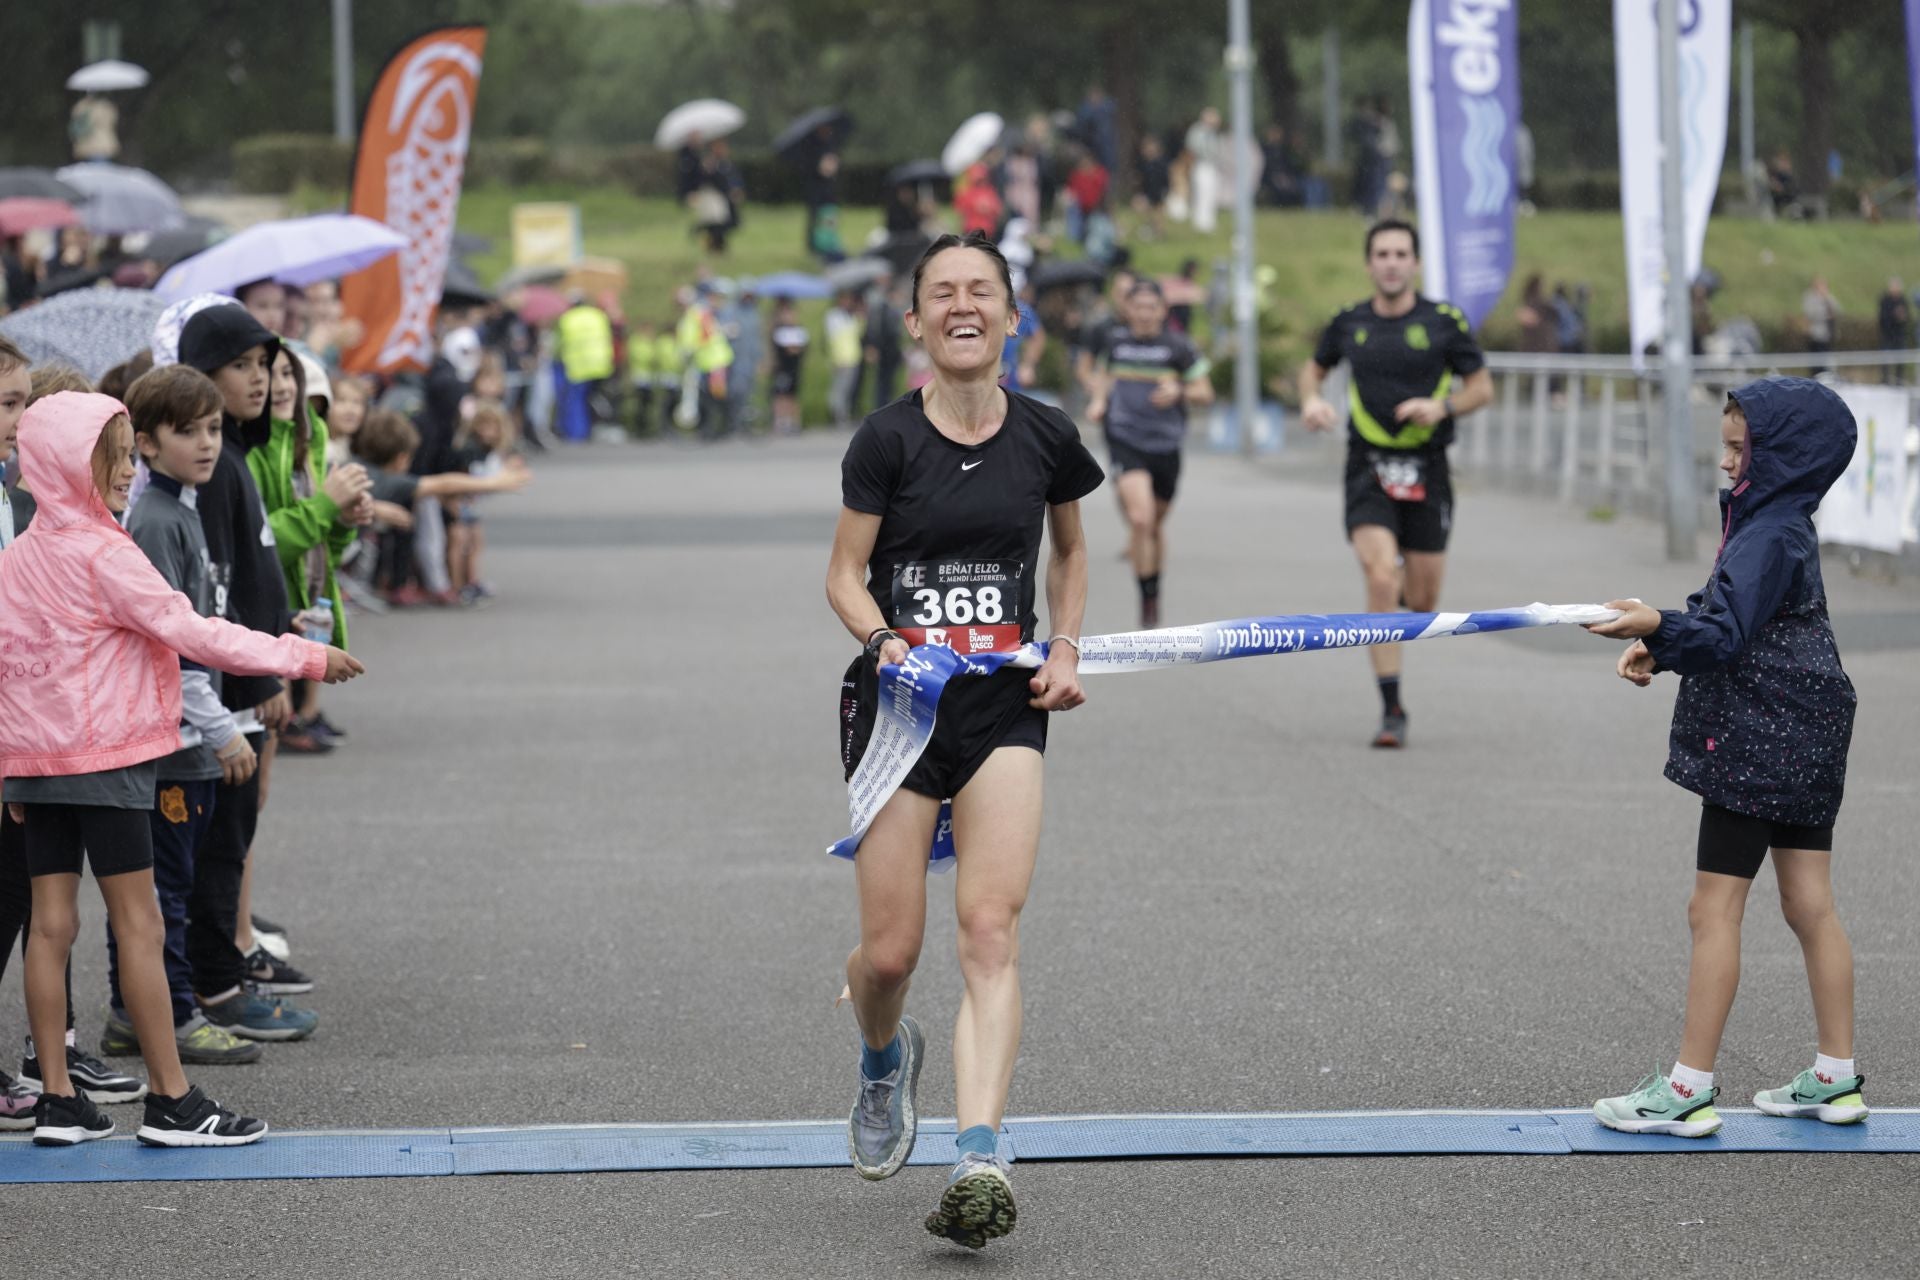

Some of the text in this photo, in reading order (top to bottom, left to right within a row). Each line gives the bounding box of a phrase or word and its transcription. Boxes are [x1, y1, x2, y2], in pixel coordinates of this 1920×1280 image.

[1436, 0, 1509, 95] ek
[938, 562, 1000, 575] BEÑAT ELZO
[970, 574, 1007, 582] LASTERKETA
[913, 586, 1003, 626] 368
[969, 628, 978, 636] EL
[969, 635, 994, 643] DIARIO
[1217, 622, 1306, 655] Txingudi
[1671, 1081, 1694, 1098] adid
